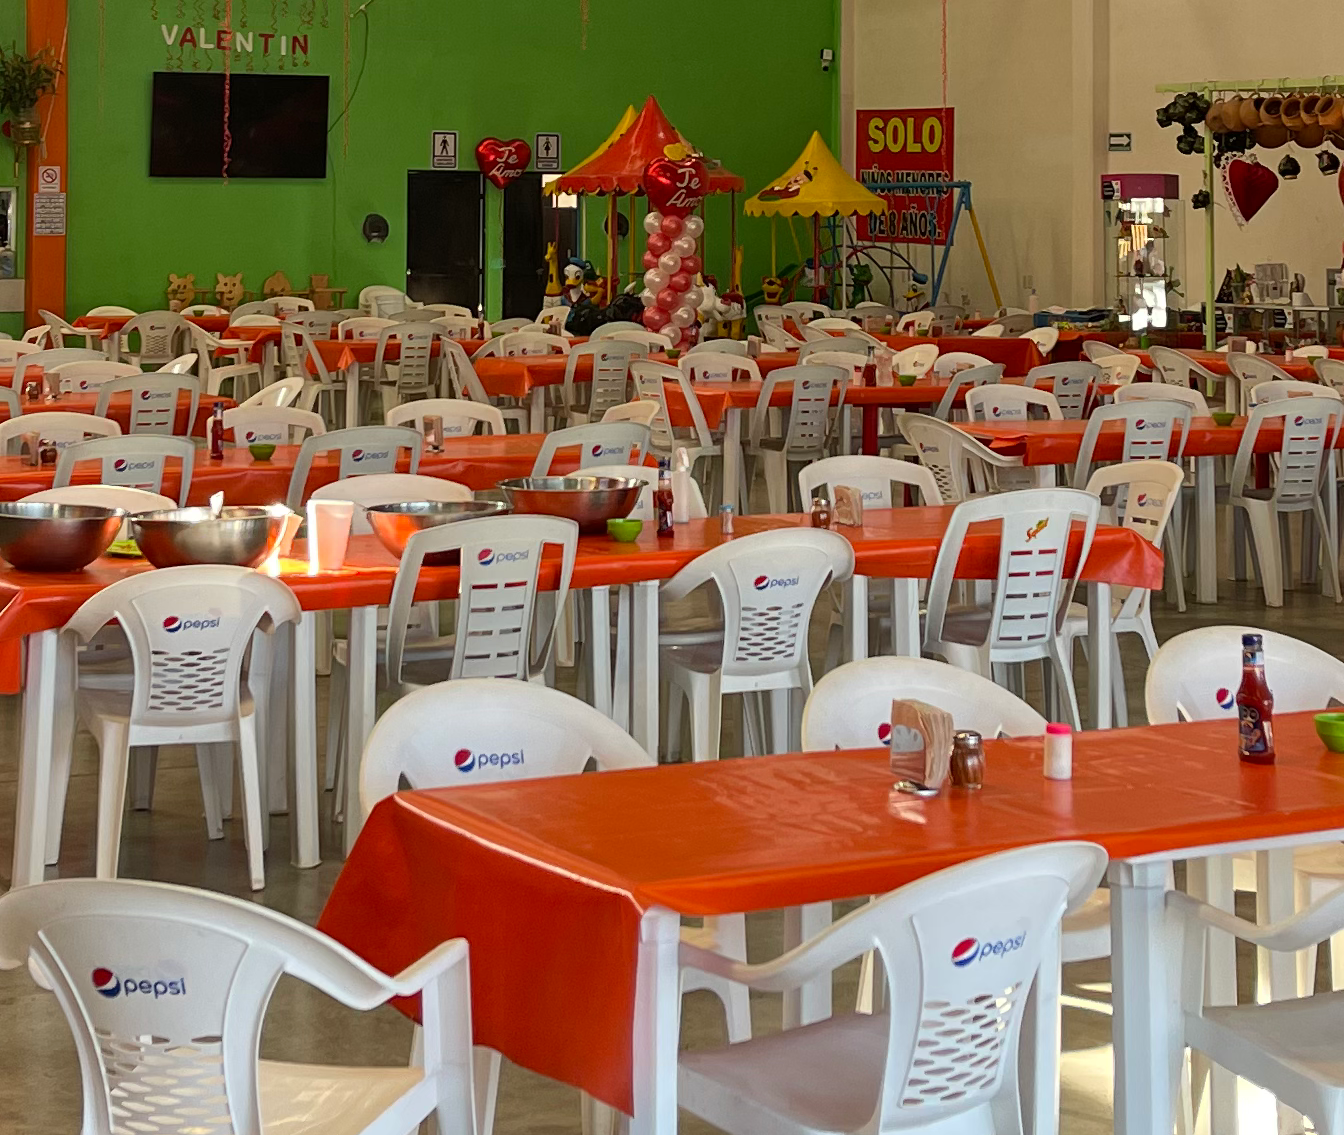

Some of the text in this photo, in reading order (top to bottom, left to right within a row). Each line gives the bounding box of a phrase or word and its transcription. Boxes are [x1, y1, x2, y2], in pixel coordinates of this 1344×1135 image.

[161, 24, 309, 56] VALENTIN
[867, 116, 943, 153] SOLO
[497, 147, 519, 163] Te
[489, 163, 523, 178] Amo
[676, 168, 701, 189] Te
[893, 169, 951, 198] MENORES
[666, 189, 703, 207] Amo
[497, 548, 529, 564] pepsi
[769, 574, 800, 590] pepsi
[183, 614, 221, 634] pepsi
[478, 749, 525, 769] pepsi
[979, 930, 1027, 962] pepsi
[124, 977, 186, 998] pepsi
